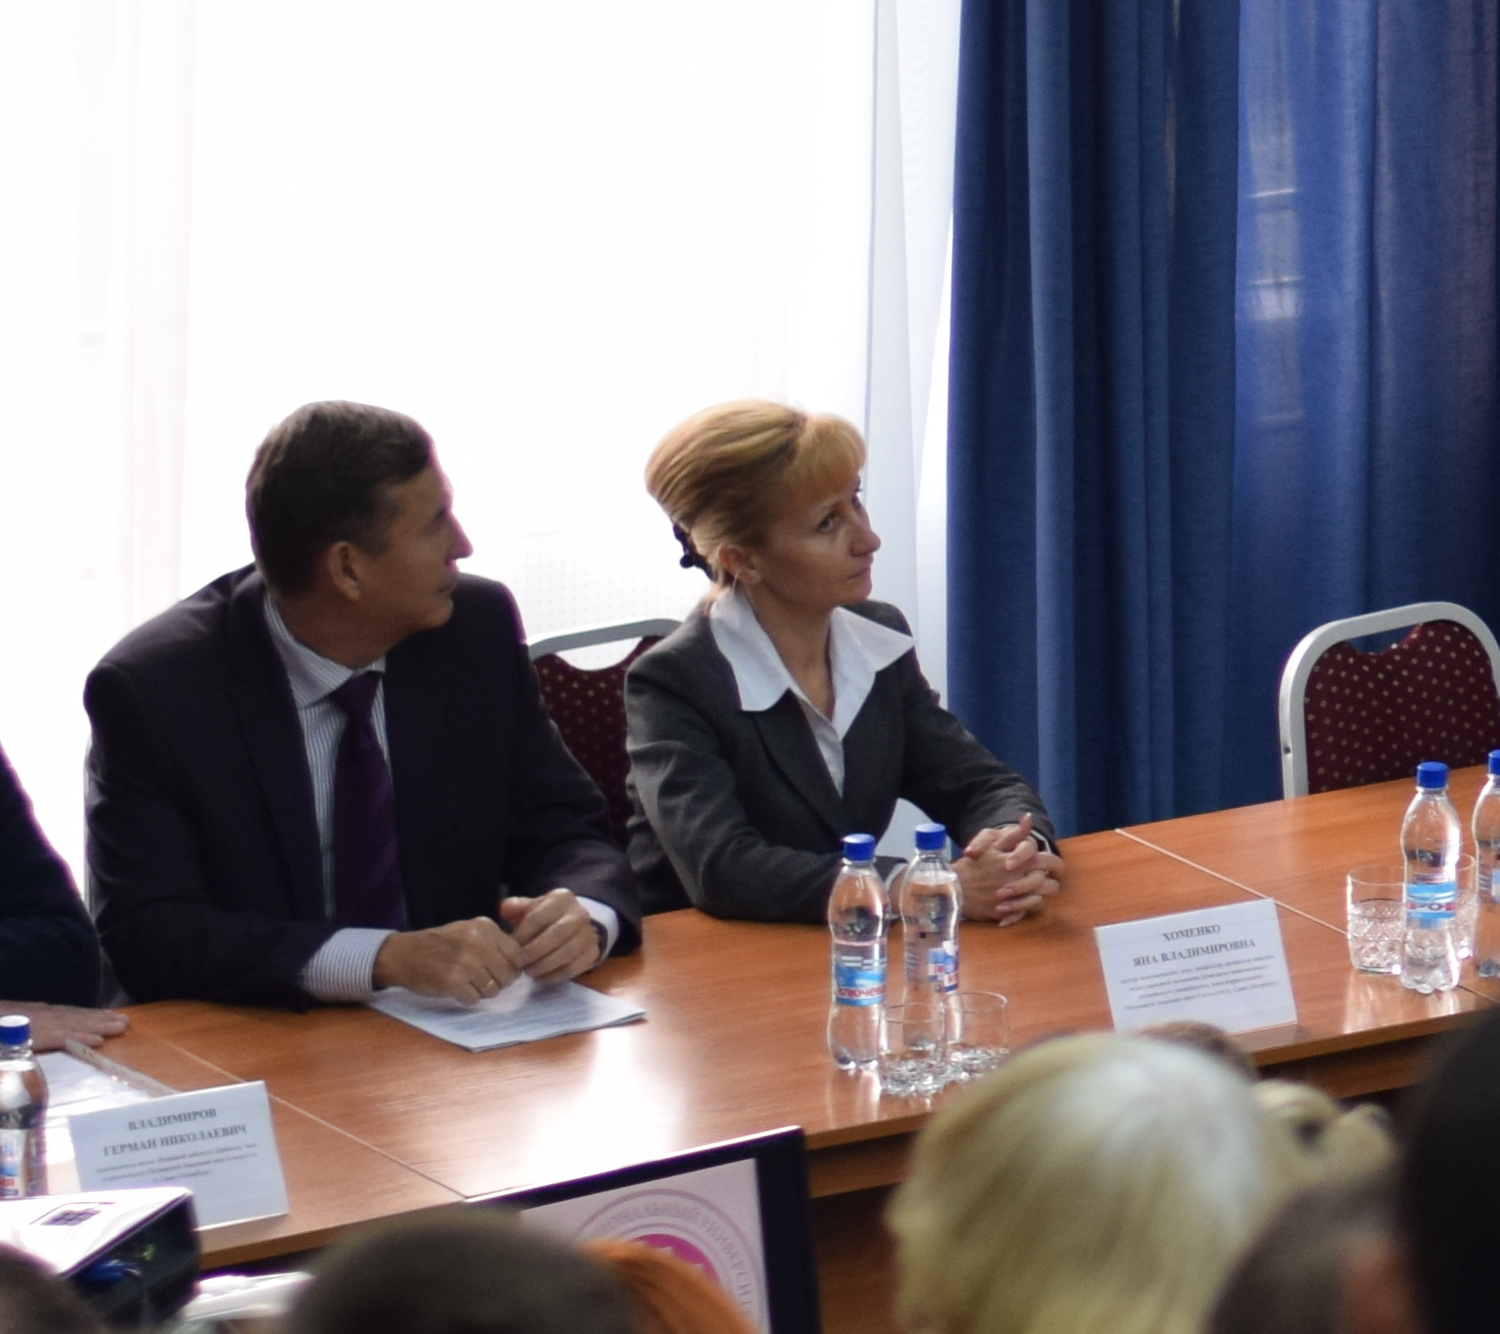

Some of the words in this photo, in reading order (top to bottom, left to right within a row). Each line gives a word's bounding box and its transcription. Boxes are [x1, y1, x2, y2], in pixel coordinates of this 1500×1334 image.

[1162, 924, 1221, 942] ХОМЕНКО
[1133, 954, 1159, 967] ЯНА
[1161, 939, 1256, 962] ВЛАДИМИРОВНА
[128, 1108, 218, 1131] ВЛАДИМИРОВ
[103, 1137, 157, 1157] ГЕРМАН
[160, 1124, 248, 1148] НИКОЛАЕВИЧ
